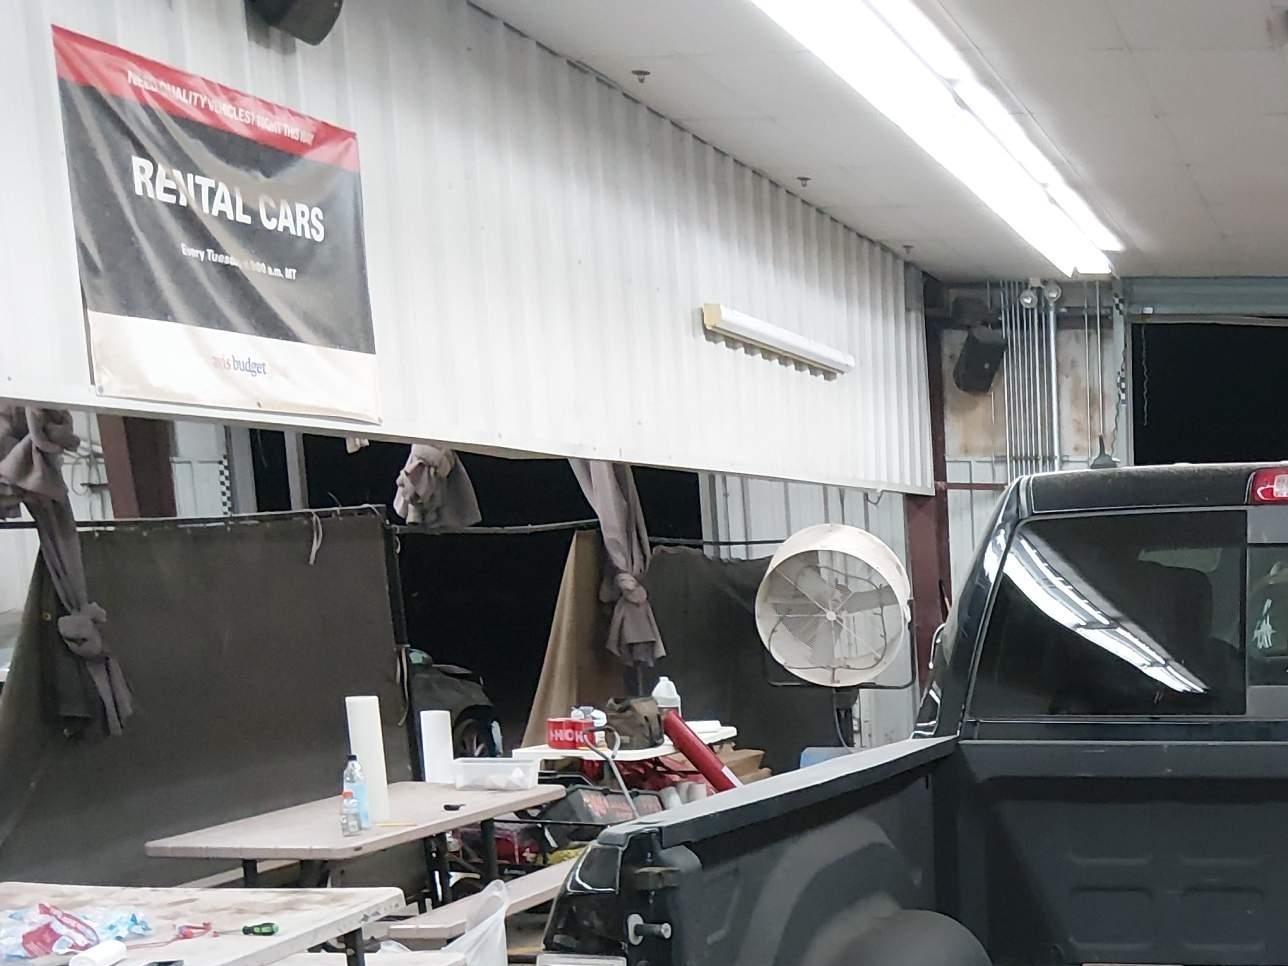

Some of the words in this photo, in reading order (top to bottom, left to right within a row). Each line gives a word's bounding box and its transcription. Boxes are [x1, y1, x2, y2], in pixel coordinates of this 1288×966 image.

[131, 155, 251, 225] RENTAL
[258, 193, 325, 243] CARS
[180, 242, 205, 263] Every
[231, 353, 267, 378] budget
